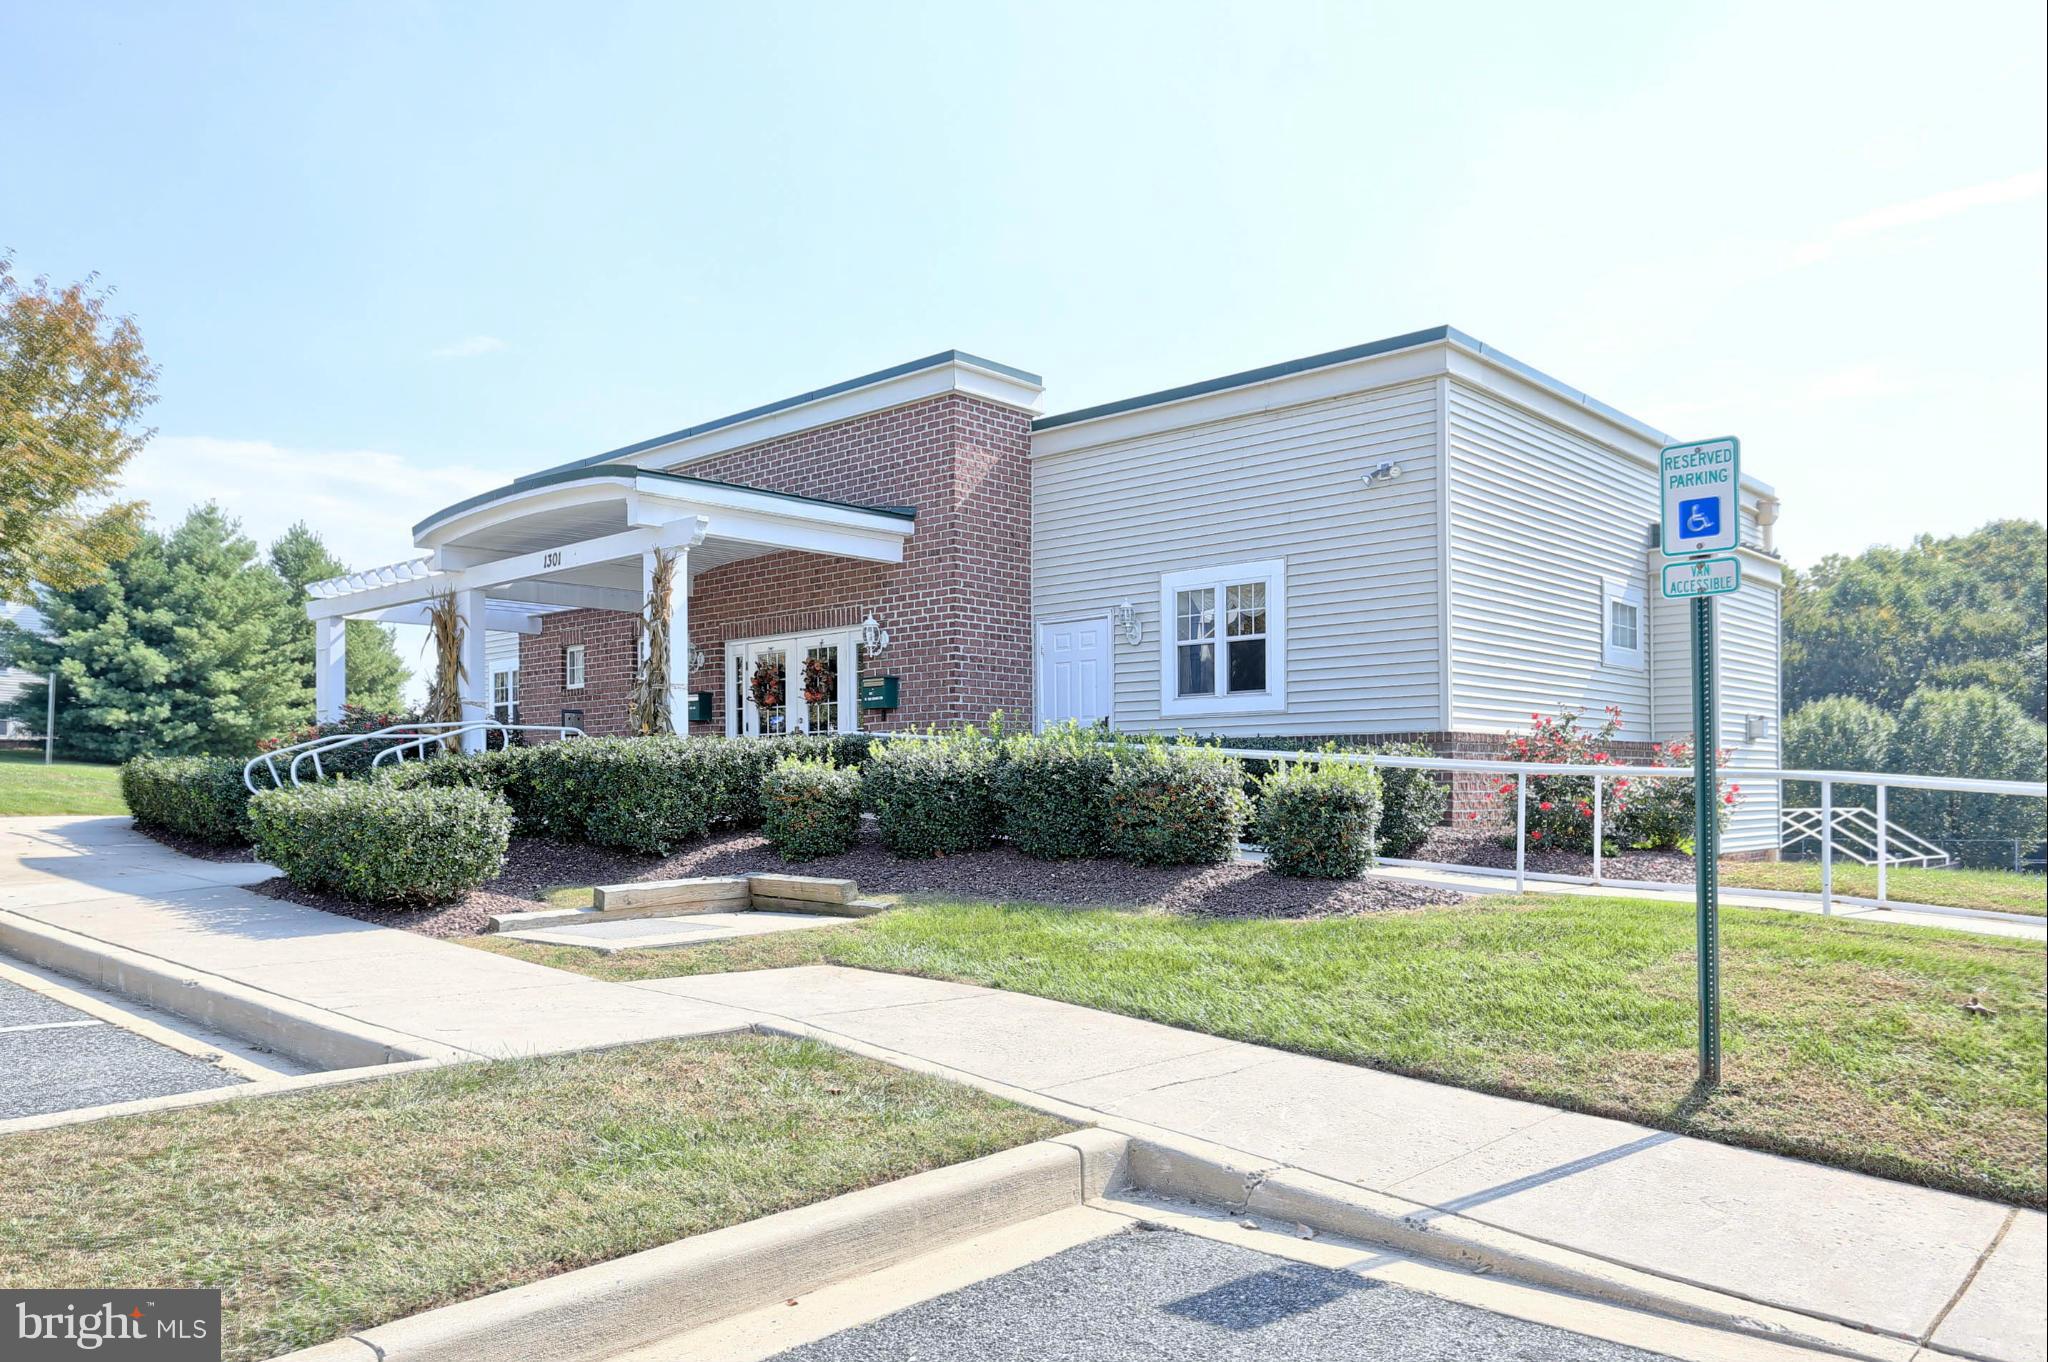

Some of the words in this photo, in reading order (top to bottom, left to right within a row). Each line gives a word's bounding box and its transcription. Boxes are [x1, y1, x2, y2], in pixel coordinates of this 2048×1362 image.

[1664, 448, 1732, 471] RESERVED
[1669, 468, 1728, 490] PARKING
[543, 552, 562, 569] 1301
[1691, 564, 1710, 577] VAN
[1670, 576, 1732, 594] ACCESSIBLE
